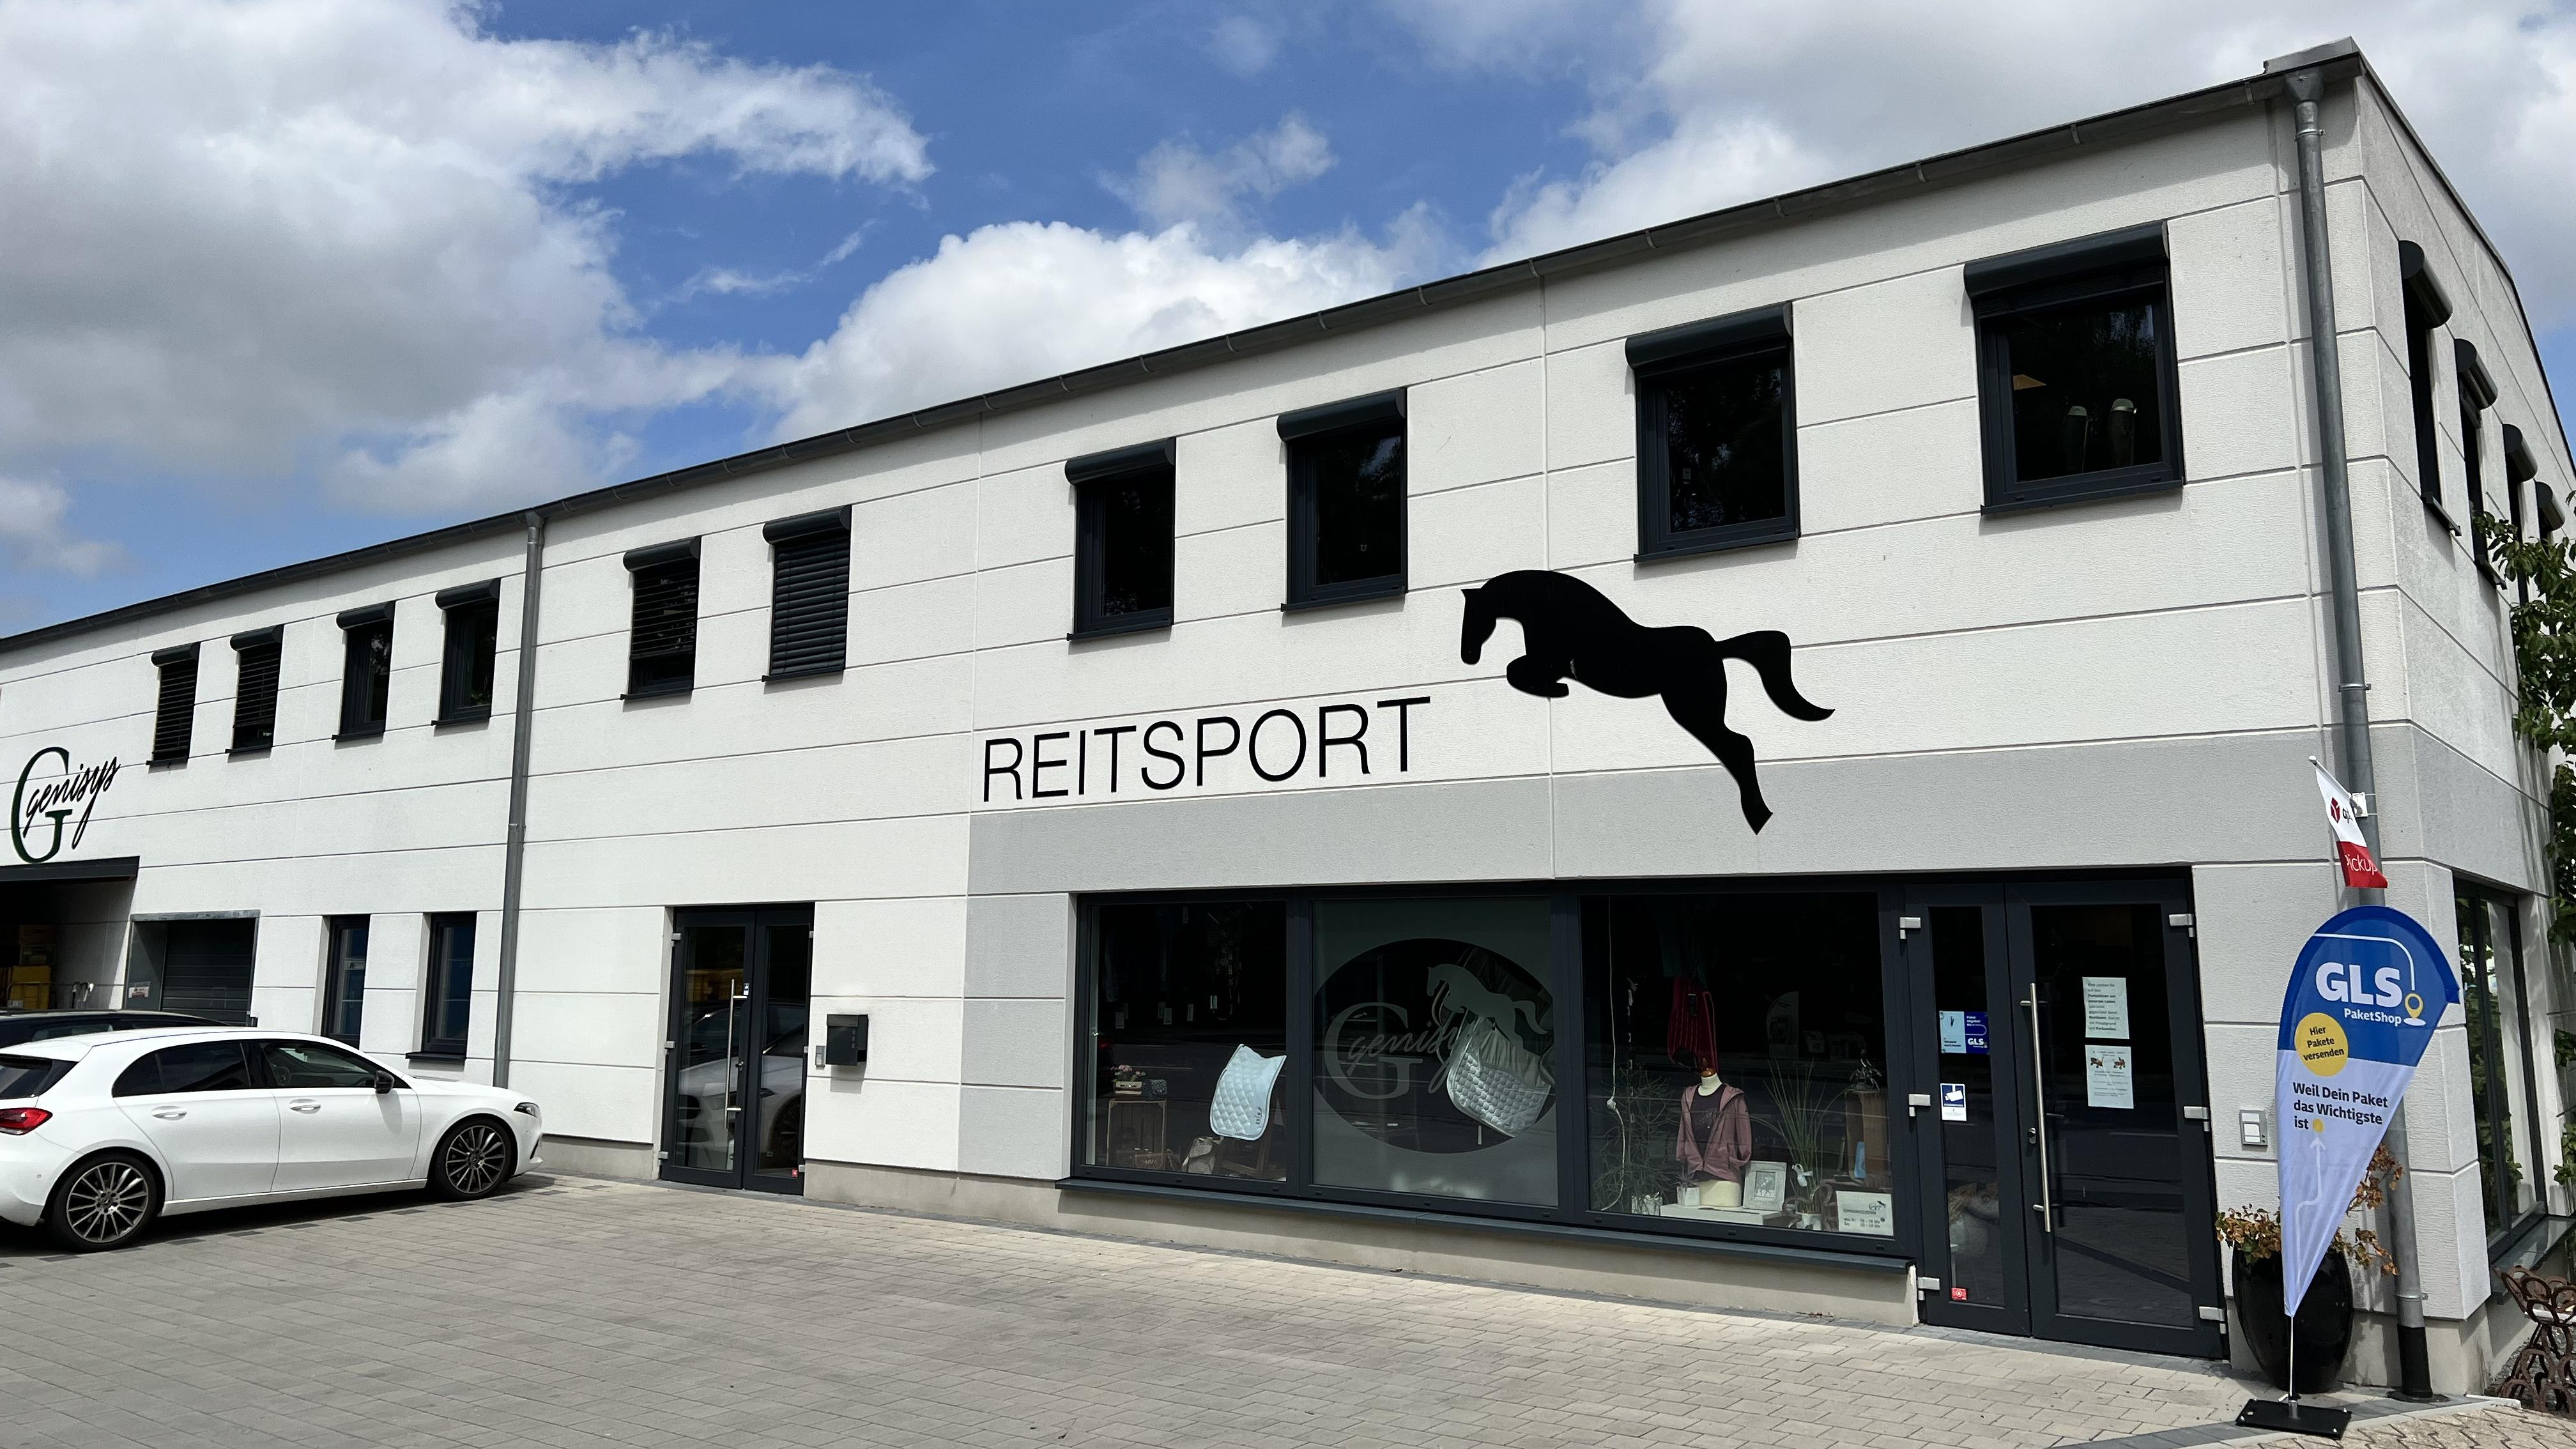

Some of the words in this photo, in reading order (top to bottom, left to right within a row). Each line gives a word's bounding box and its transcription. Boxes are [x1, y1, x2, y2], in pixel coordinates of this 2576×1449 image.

[983, 696, 1431, 802] REITSPORT
[10, 746, 73, 864] G
[2315, 962, 2403, 1008] GLS
[2343, 1008, 2402, 1027] PaketShop
[1967, 1038, 1984, 1046] GLS
[2309, 1026, 2327, 1036] Hier
[1323, 1002, 1423, 1100] G
[2306, 1037, 2335, 1048] Pakete
[2303, 1048, 2345, 1062] versenden
[2292, 1081, 2320, 1098] Weil
[2322, 1086, 2350, 1103] Dein
[2352, 1091, 2388, 1108] Paket
[2293, 1100, 2314, 1114] das
[2315, 1102, 2383, 1126] Wichtigste
[2294, 1115, 2310, 1130] ist
